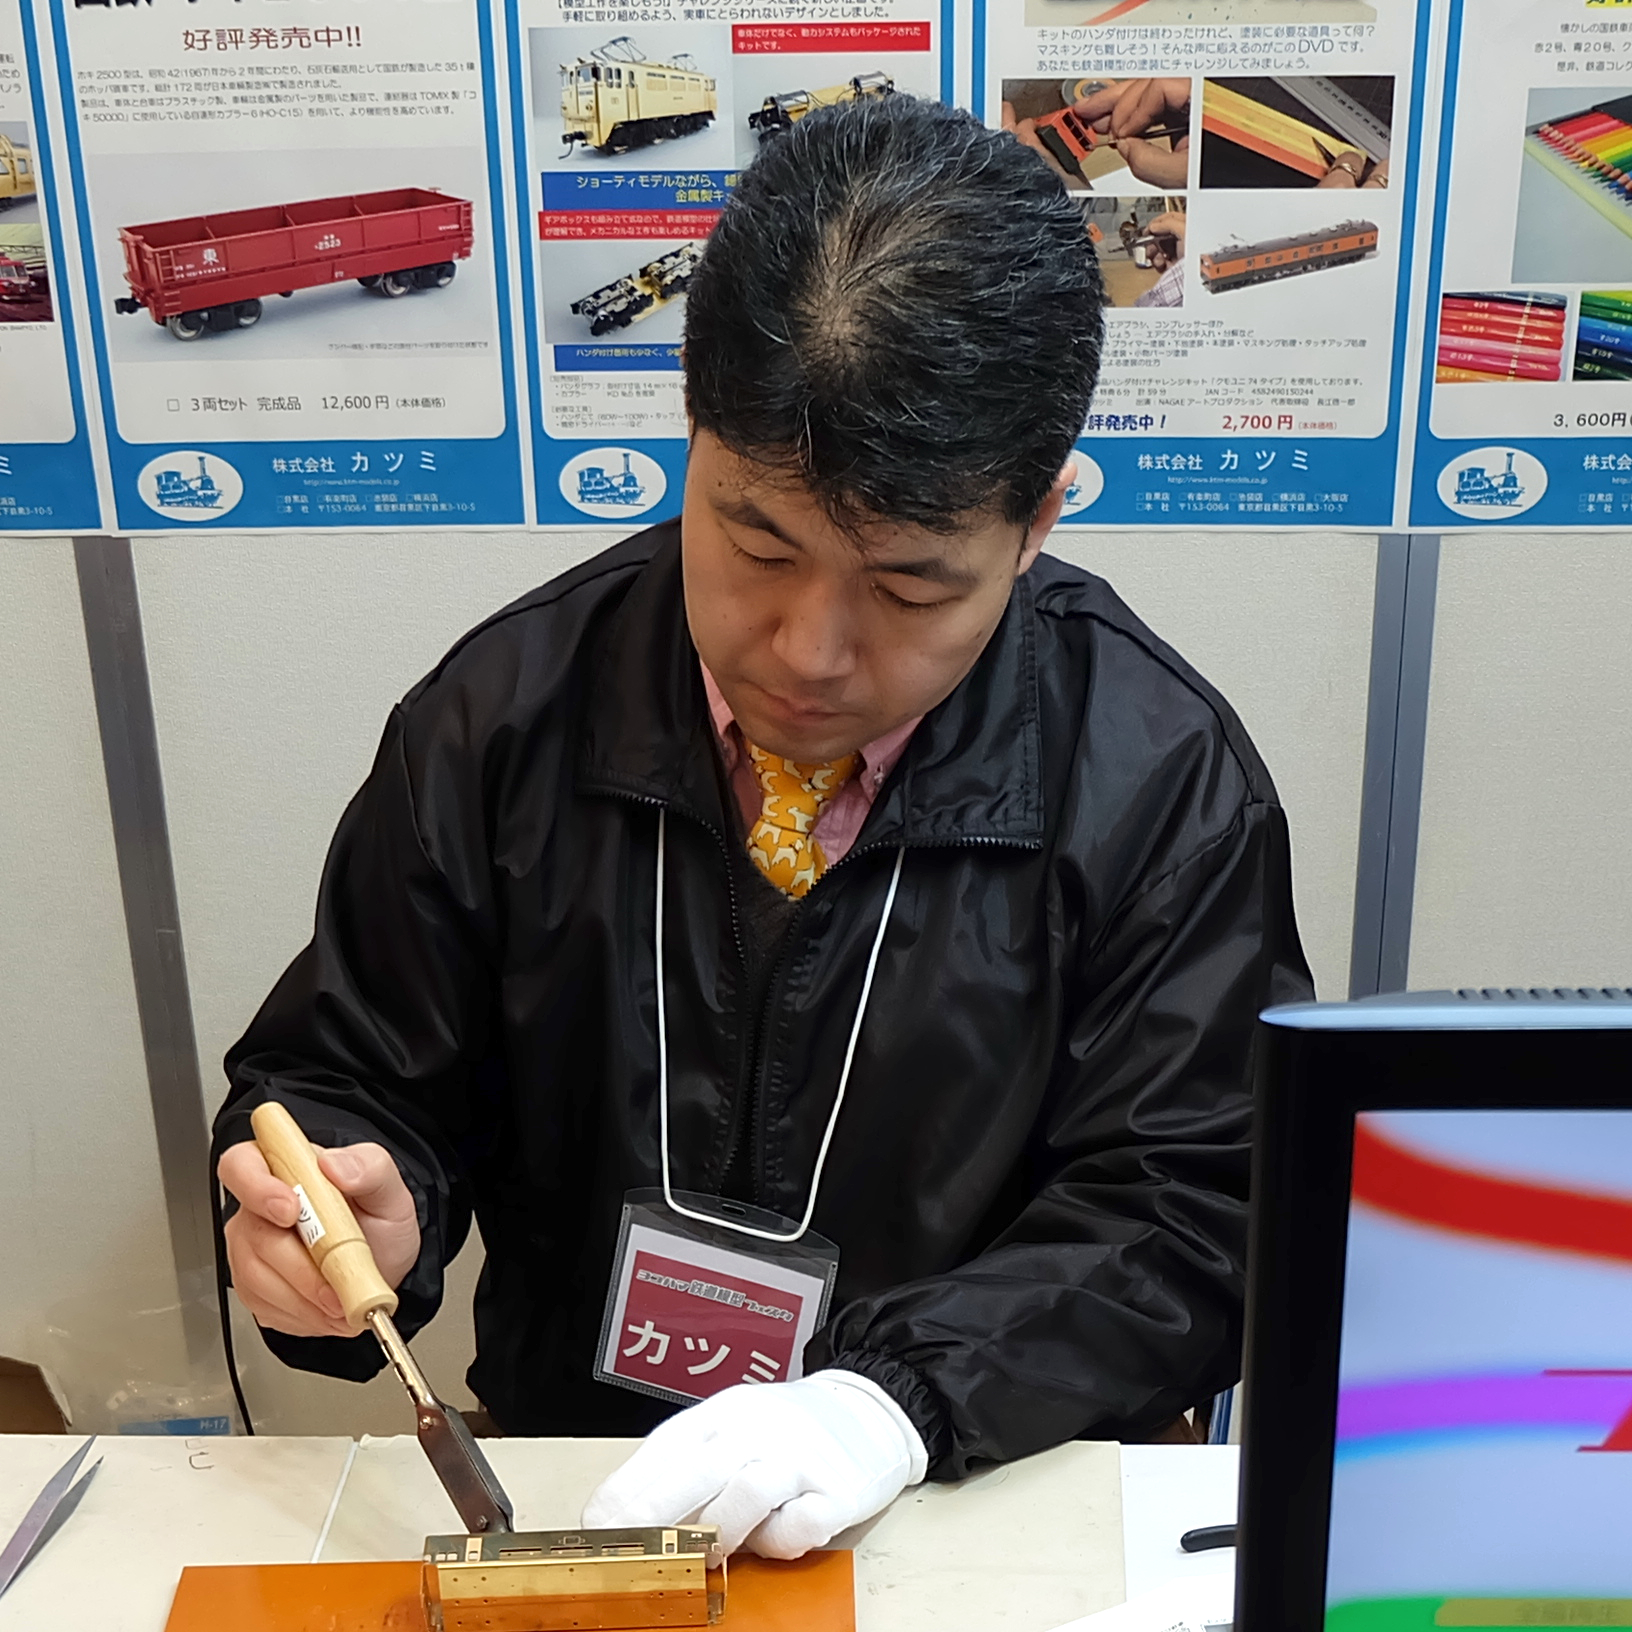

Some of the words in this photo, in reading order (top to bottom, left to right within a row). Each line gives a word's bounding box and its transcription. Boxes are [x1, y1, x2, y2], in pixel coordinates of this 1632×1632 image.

[182, 25, 363, 52] 好評発売中!!
[257, 397, 301, 411] 完成品
[1222, 414, 1272, 432] 2,700
[272, 458, 336, 474] 株式会社
[351, 450, 437, 472] カツミ
[1137, 453, 1204, 471] 株式会社
[1220, 449, 1309, 471] カツミ
[622, 1320, 781, 1385] カツミ
